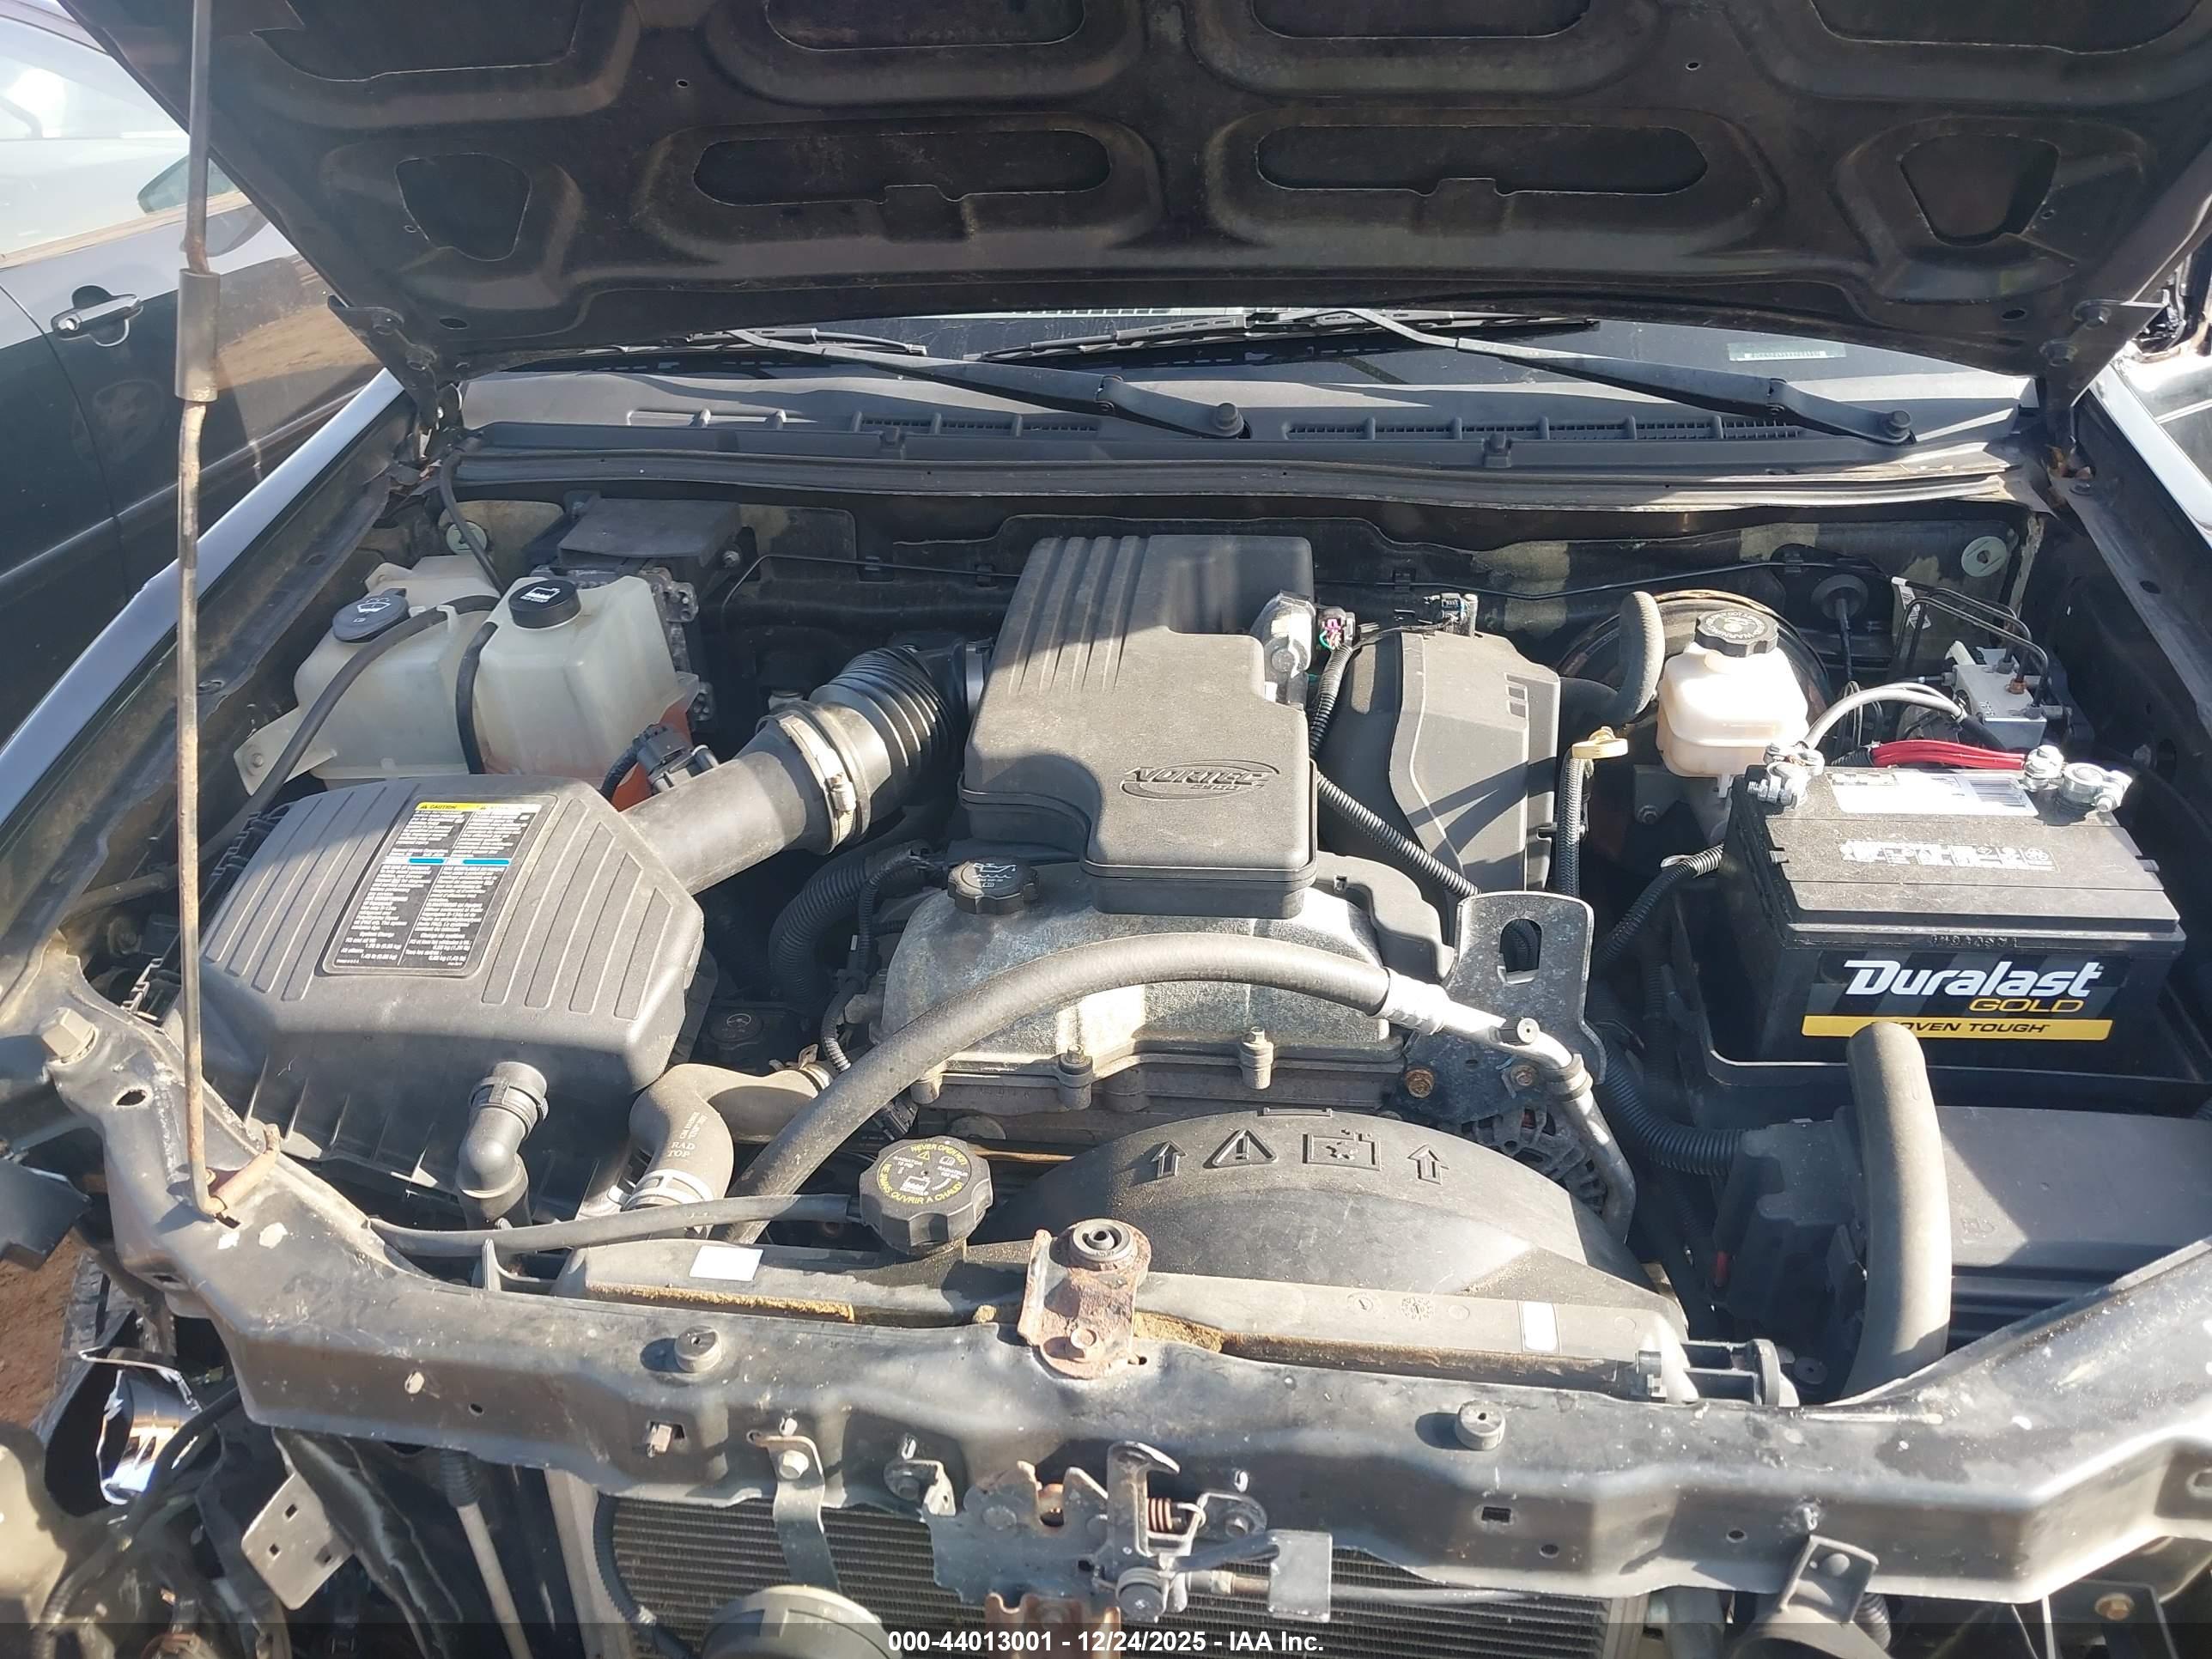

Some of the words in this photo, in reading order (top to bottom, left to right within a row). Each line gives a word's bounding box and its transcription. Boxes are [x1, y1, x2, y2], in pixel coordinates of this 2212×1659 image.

[1127, 767, 1271, 784] VORTEC
[1844, 959, 2103, 998] Duralast
[1969, 997, 2085, 1013] GOLD
[1969, 1023, 2047, 1033] TOUGH
[672, 1141, 696, 1151] RAD
[910, 1144, 937, 1152] NEVER
[667, 1150, 690, 1158] TOP
[890, 1191, 924, 1205] OUVRIR
